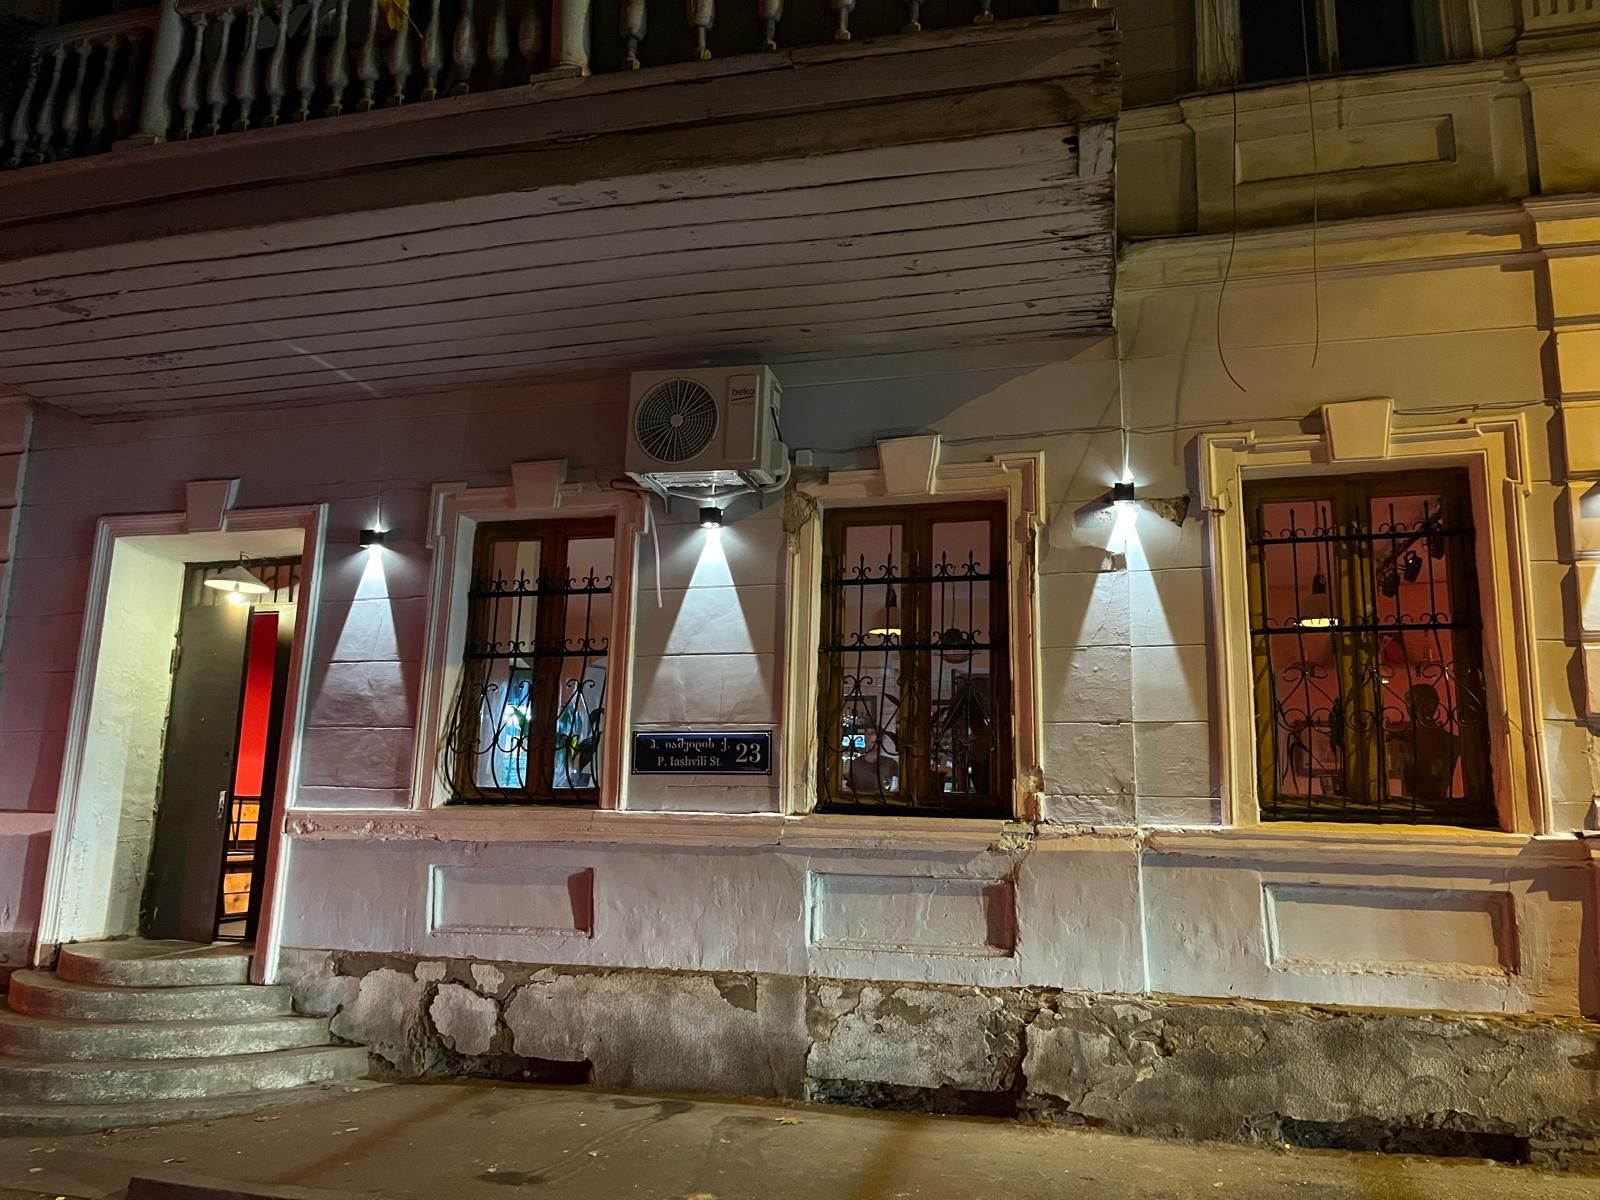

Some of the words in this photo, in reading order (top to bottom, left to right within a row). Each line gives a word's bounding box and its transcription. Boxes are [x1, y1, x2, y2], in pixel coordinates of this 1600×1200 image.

[732, 387, 755, 396] beko
[665, 737, 715, 752] იაშვილის
[735, 743, 761, 763] 23
[657, 755, 667, 767] P.
[670, 755, 707, 767] Iashvili
